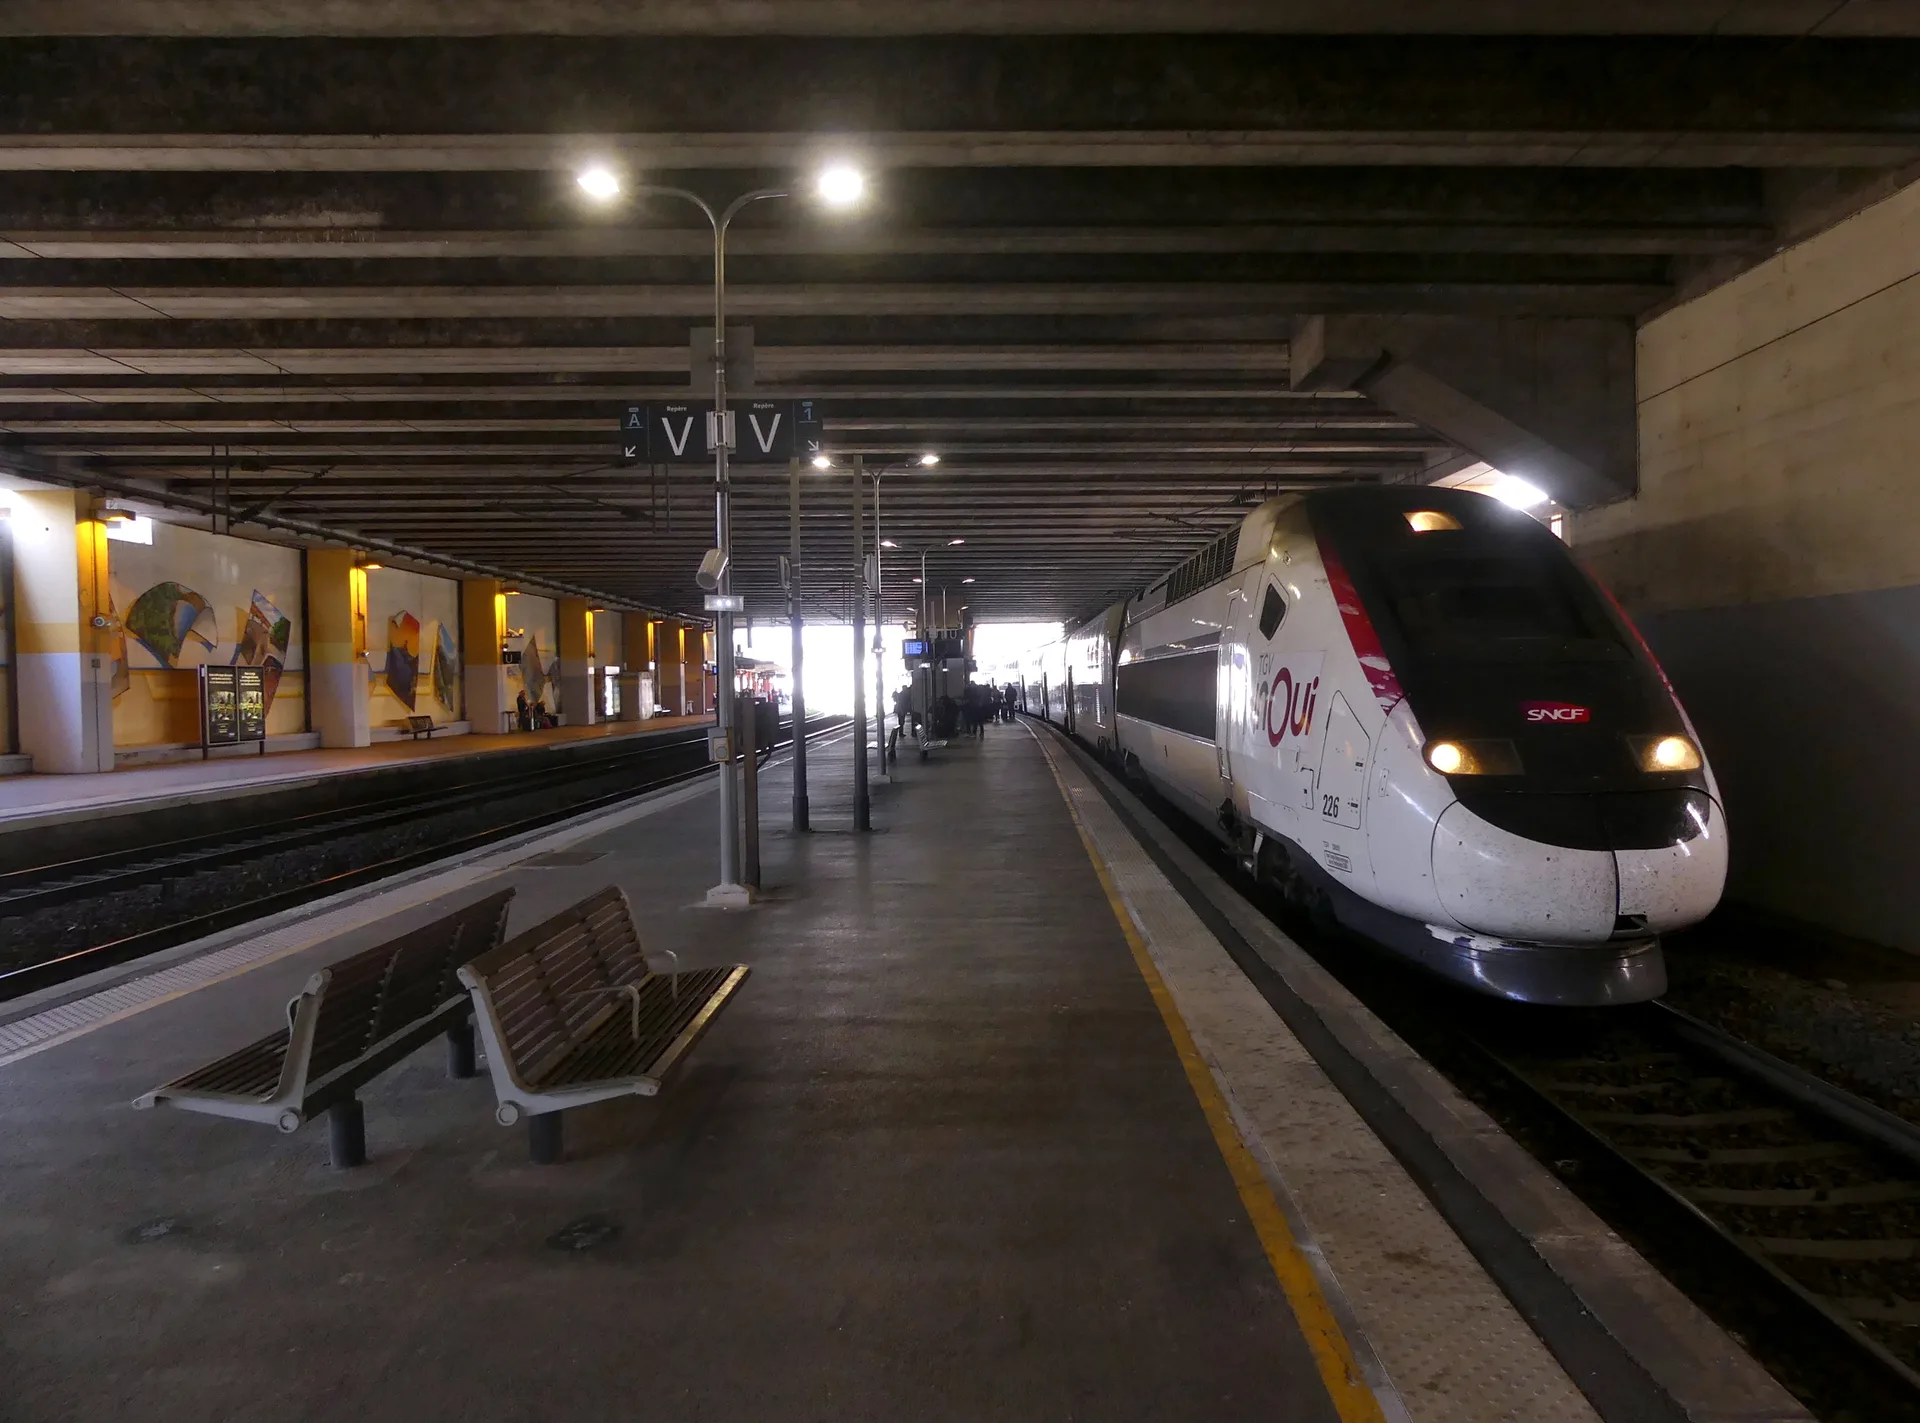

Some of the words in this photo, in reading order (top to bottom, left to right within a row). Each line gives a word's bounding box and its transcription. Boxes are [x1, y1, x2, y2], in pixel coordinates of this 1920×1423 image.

[629, 413, 640, 426] A
[804, 408, 811, 420] 1
[661, 416, 693, 456] V
[748, 413, 781, 452] V
[1259, 653, 1274, 675] TGV
[1527, 708, 1584, 720] SNCF
[1323, 794, 1340, 818] 226
